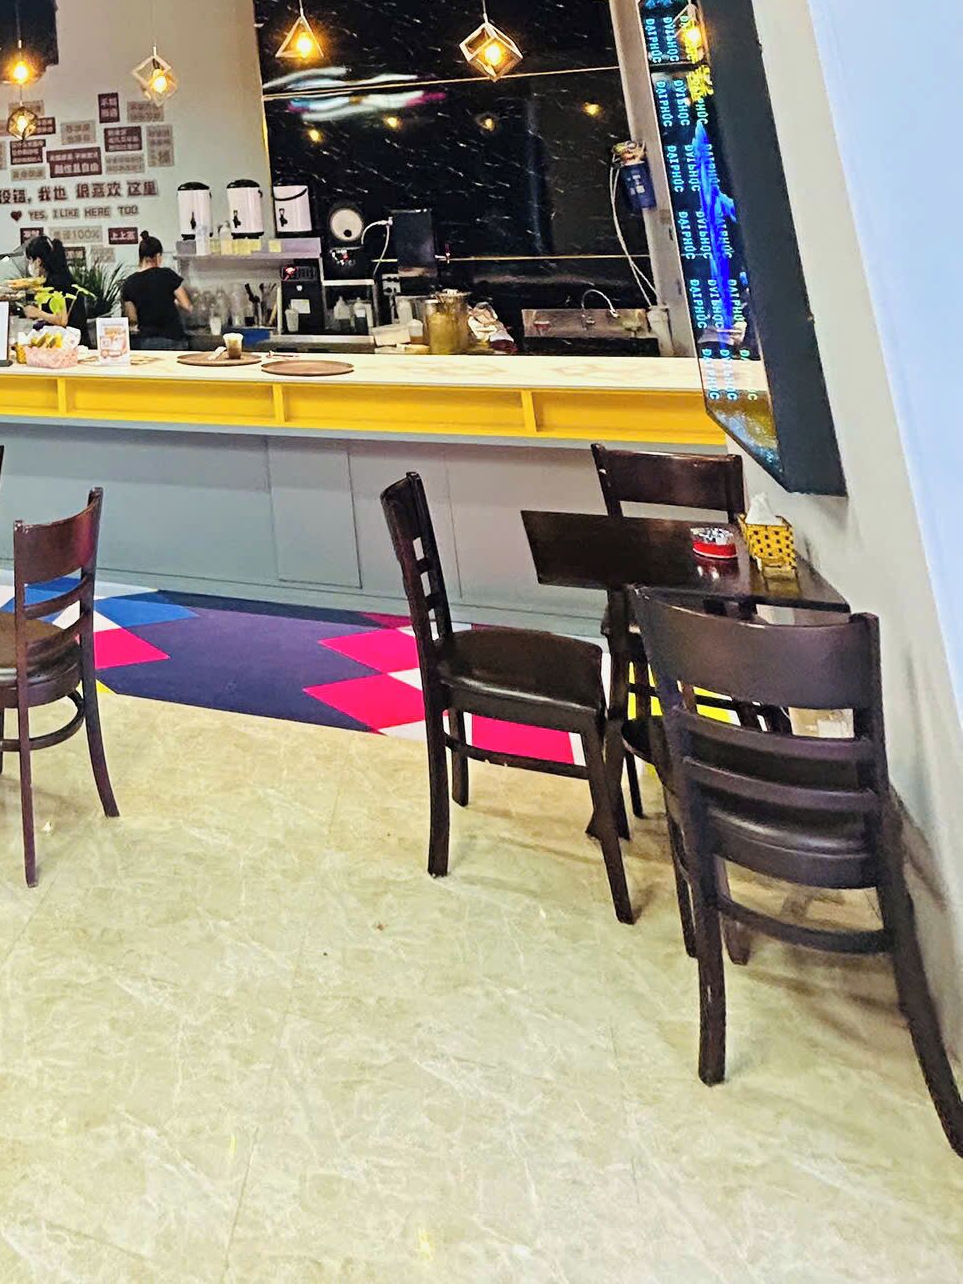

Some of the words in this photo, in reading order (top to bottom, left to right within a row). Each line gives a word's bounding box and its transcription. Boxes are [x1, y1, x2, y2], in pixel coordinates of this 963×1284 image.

[76, 181, 122, 198] 很喜欢
[127, 180, 159, 197] 这里
[84, 206, 110, 218] HERE
